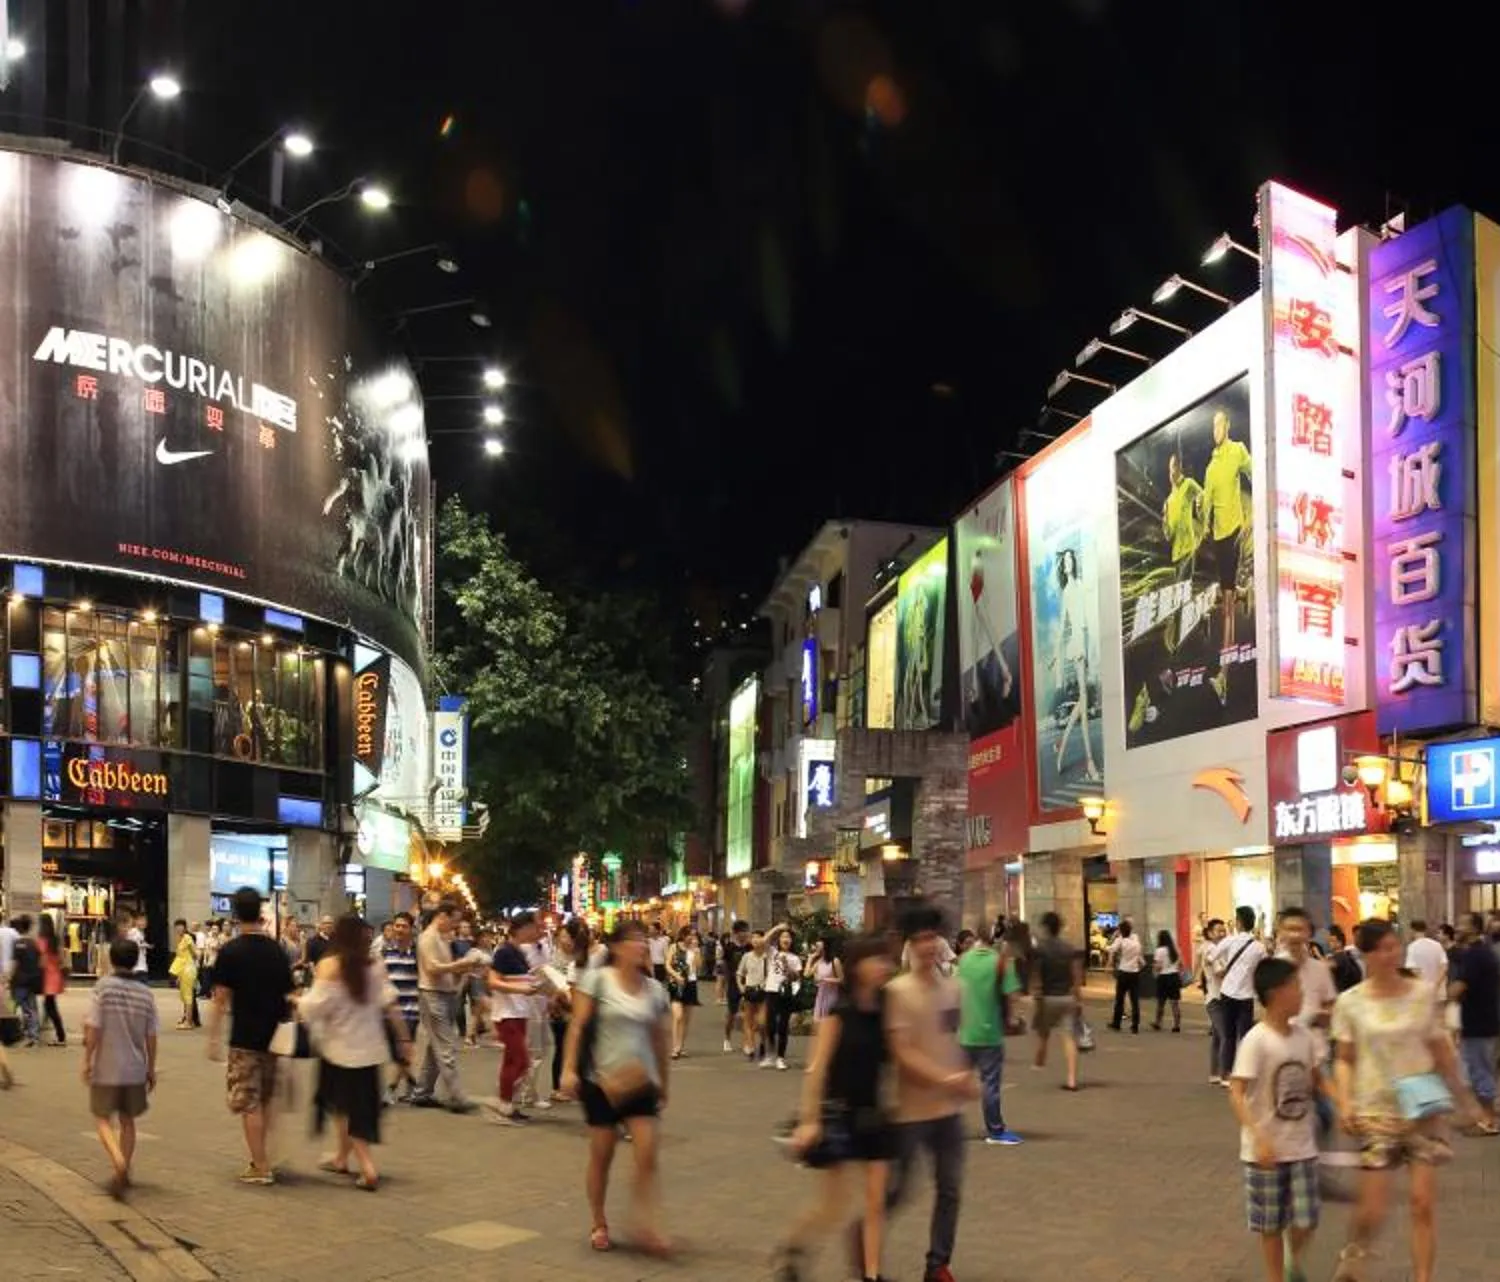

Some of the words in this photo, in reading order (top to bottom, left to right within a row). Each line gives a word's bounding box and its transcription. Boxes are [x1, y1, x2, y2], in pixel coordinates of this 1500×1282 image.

[1288, 299, 1345, 638] 安踏体育
[1383, 258, 1443, 694] 天河城百货
[67, 757, 168, 795] Cabbeen
[357, 671, 380, 757] Cabbeen
